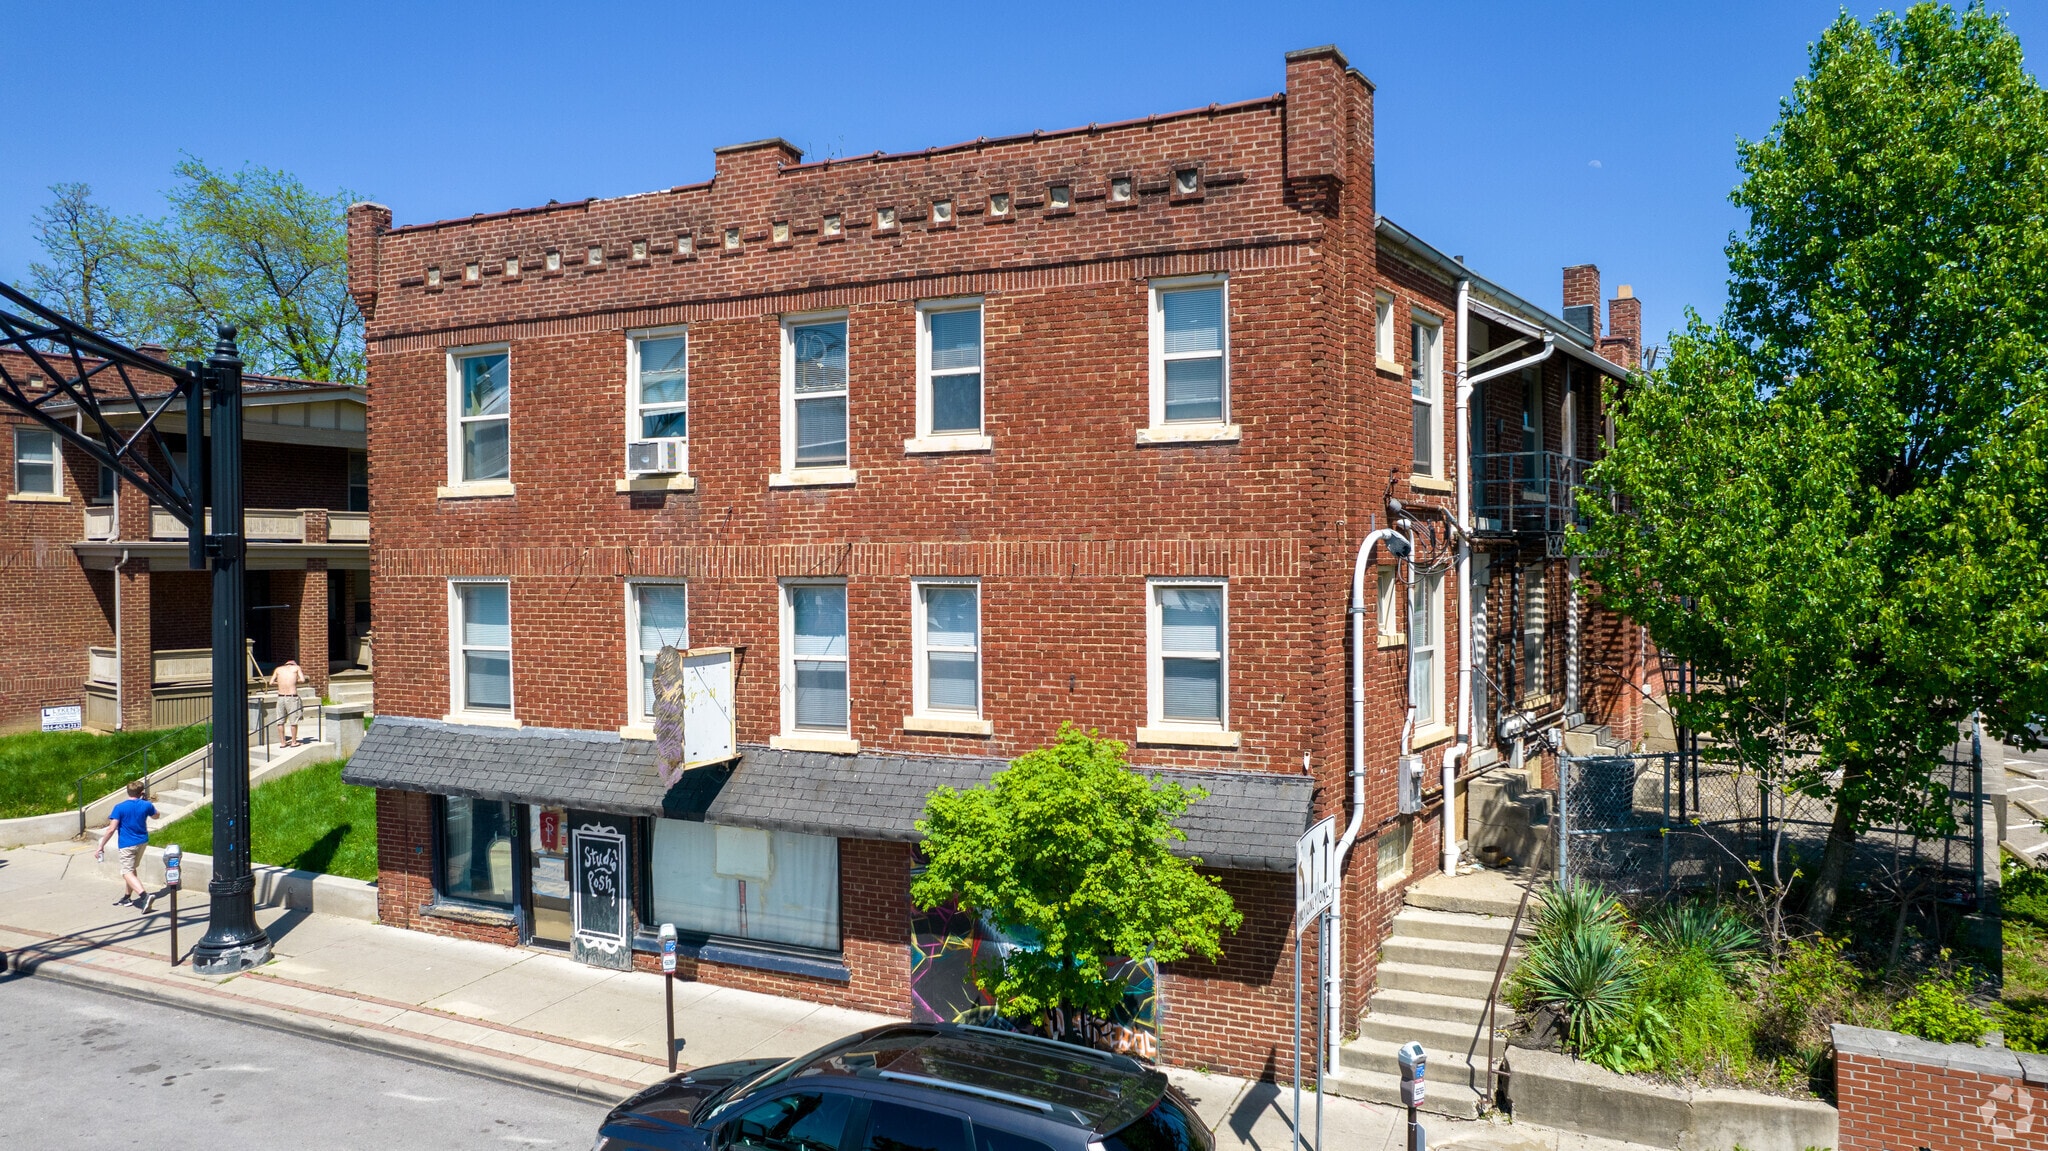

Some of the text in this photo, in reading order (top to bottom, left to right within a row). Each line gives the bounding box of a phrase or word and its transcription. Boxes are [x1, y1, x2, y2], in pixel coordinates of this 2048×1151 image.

[584, 846, 619, 872] Studio
[588, 871, 616, 907] Posh
[1319, 883, 1333, 903] ONLY
